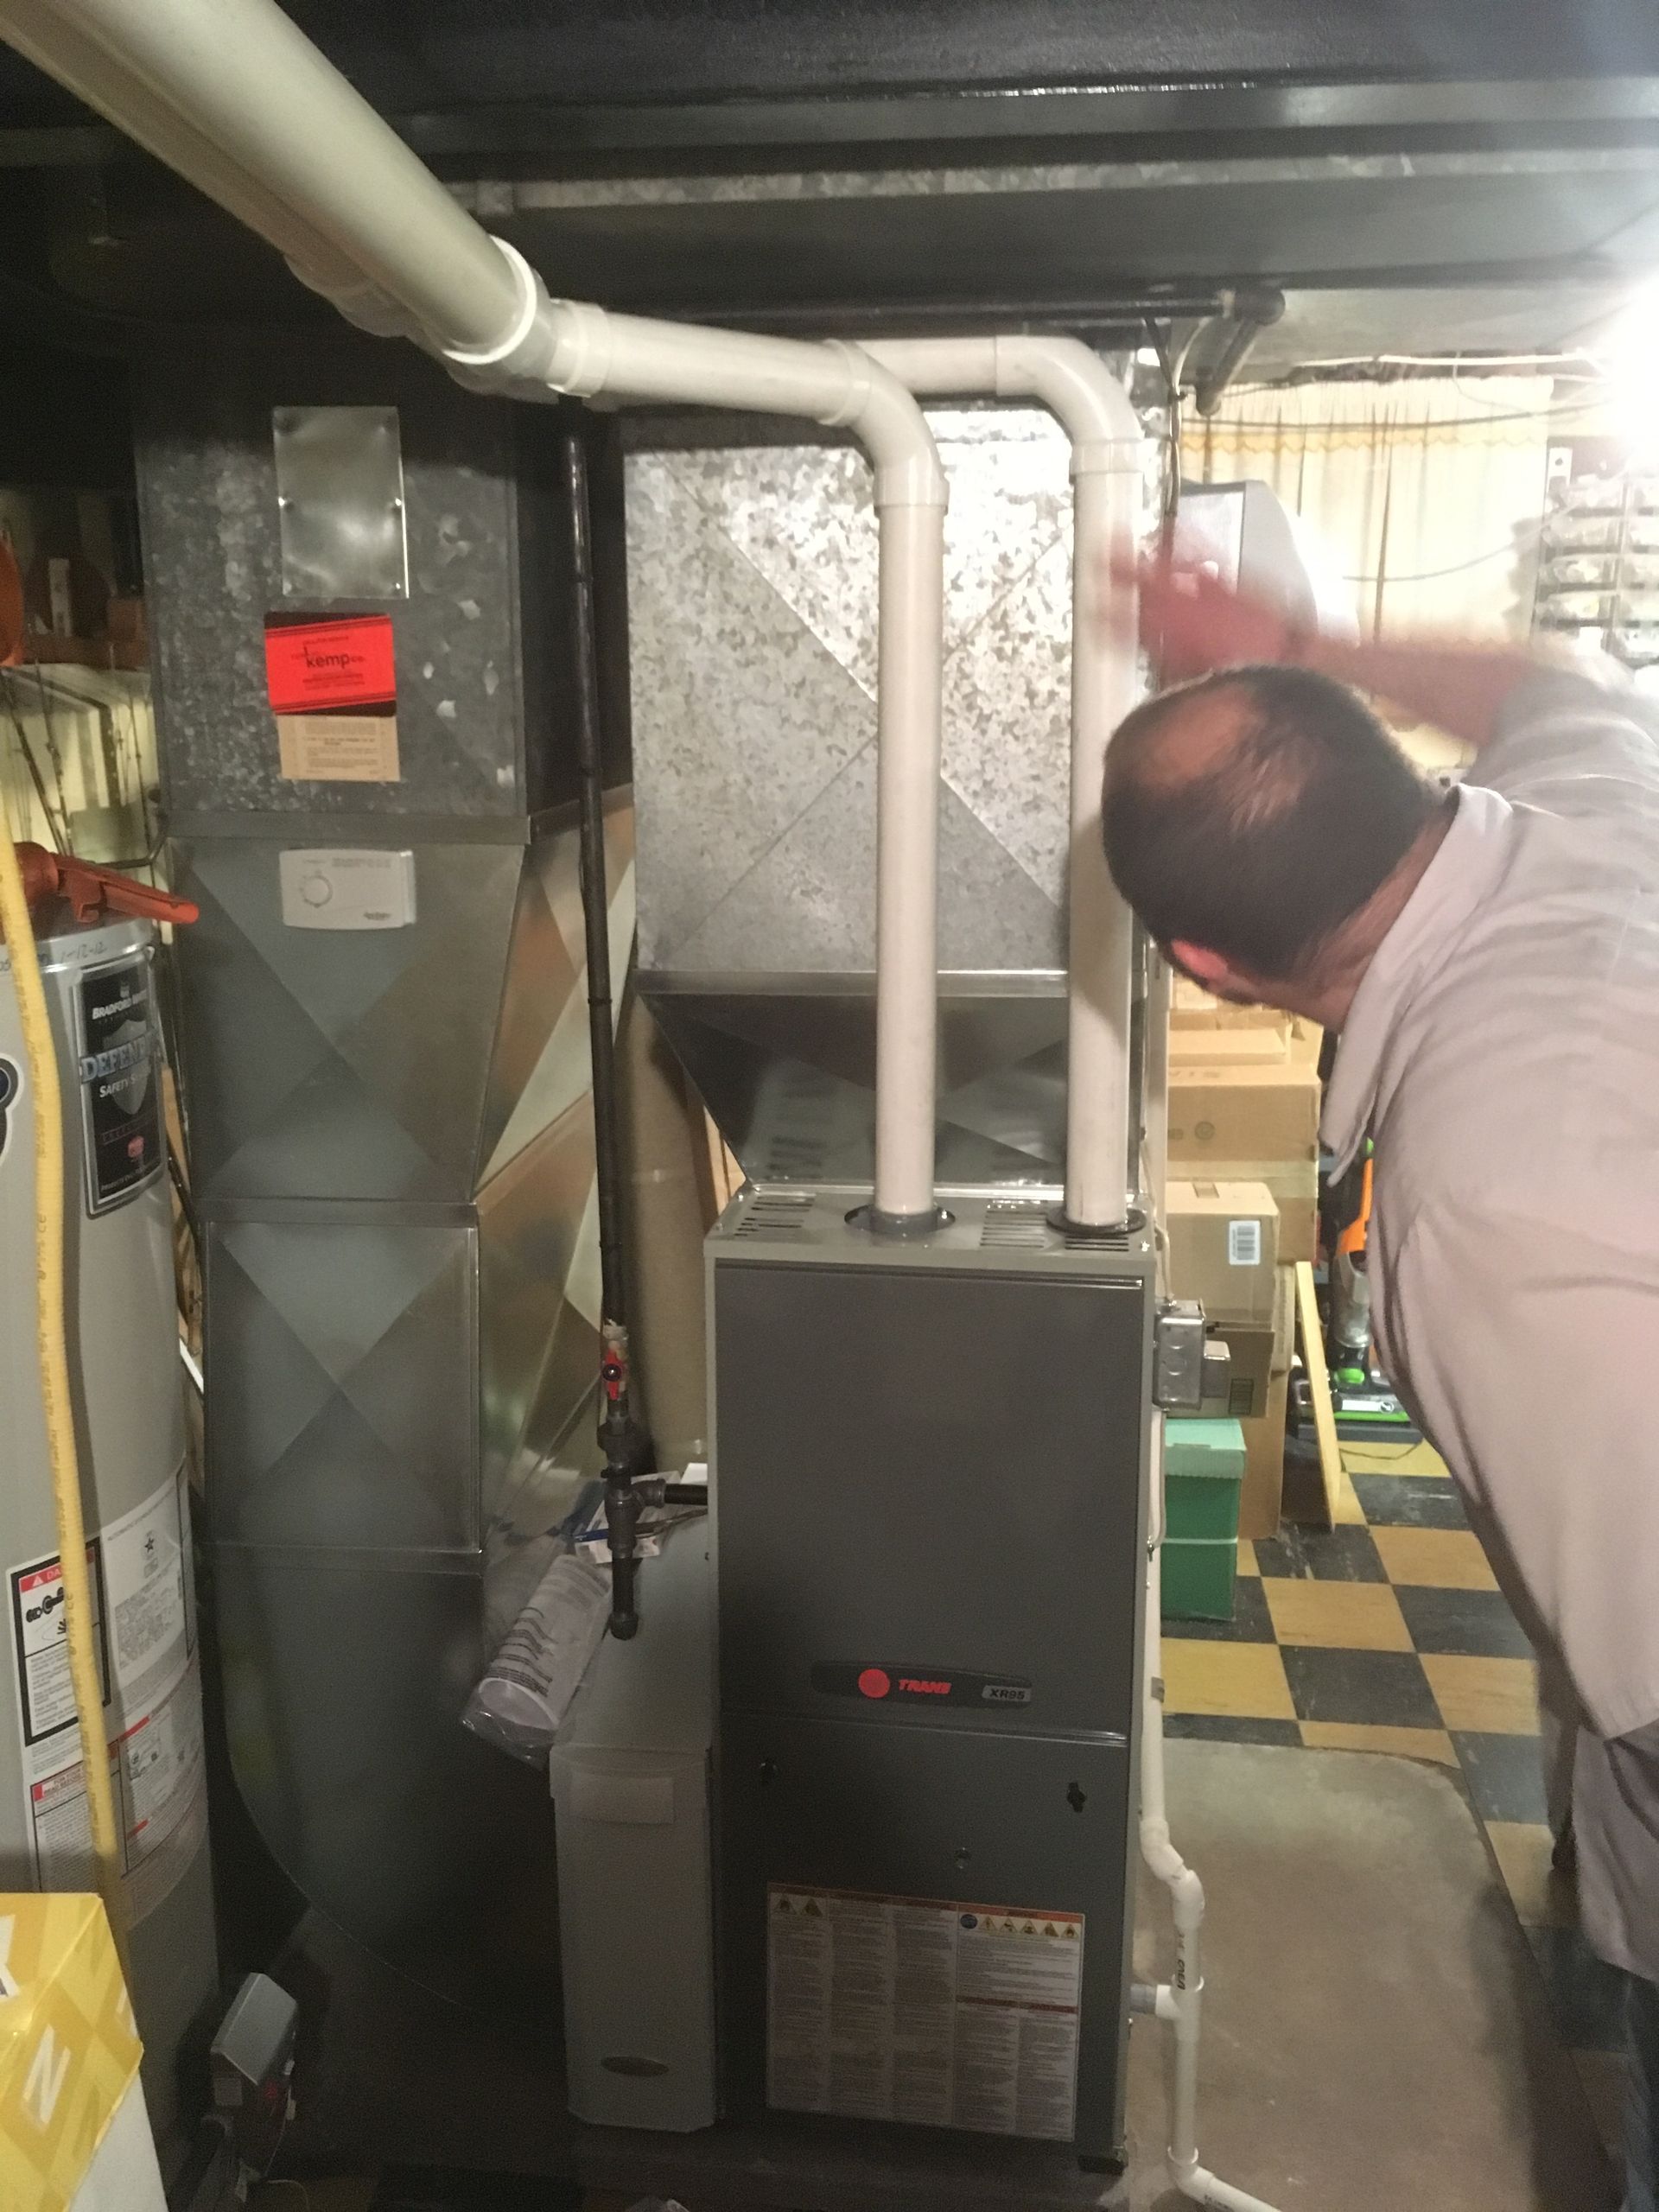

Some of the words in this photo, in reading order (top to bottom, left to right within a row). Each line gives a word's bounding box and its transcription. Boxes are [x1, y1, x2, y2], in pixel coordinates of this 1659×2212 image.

[303, 646, 351, 670] kemp
[92, 997, 132, 1020] BRADFORD
[99, 1077, 129, 1098] SAFETY
[988, 1688, 1027, 1700] XR95
